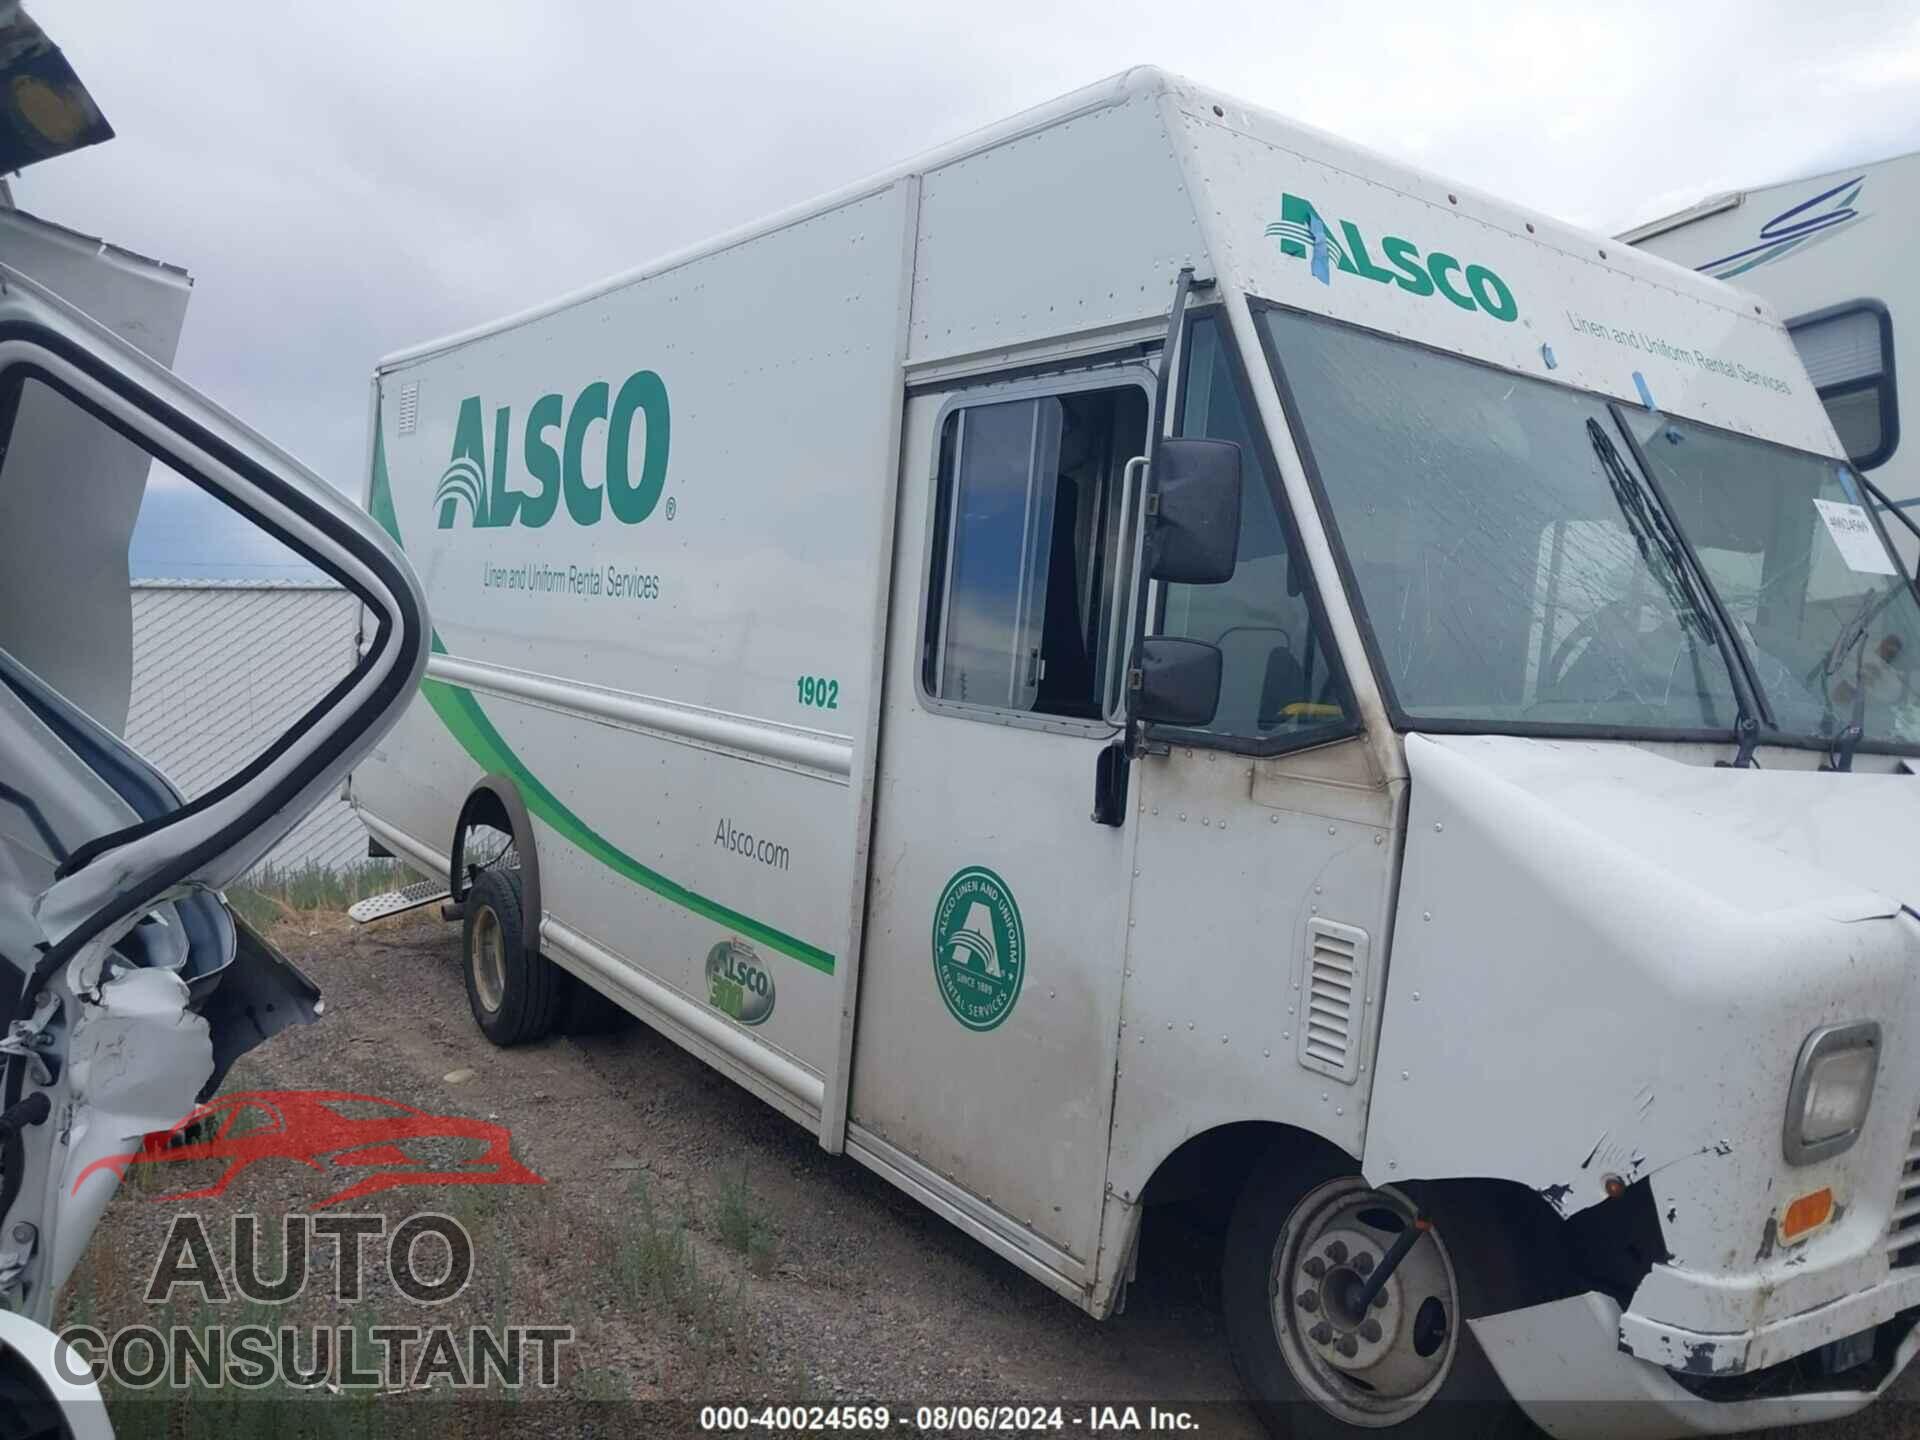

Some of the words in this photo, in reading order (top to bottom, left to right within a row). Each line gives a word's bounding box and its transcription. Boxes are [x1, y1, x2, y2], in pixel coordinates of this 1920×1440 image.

[1265, 192, 1518, 322] ALSCO
[1565, 309, 1610, 341] Linen
[1612, 326, 1639, 350] and
[1641, 333, 1697, 369] Uniform
[1693, 350, 1739, 379] Rental
[1736, 363, 1793, 396] Services
[433, 369, 670, 529] ALSCO
[484, 561, 507, 588] Linen
[508, 564, 527, 590] and
[529, 563, 566, 593] Uniform
[568, 564, 603, 596] Rental
[607, 565, 660, 600] Services
[797, 675, 839, 709] 1902
[713, 817, 790, 871] Alsco.com
[941, 896, 957, 937] ALSCO
[955, 881, 978, 899] LINEN
[980, 882, 999, 901] AND
[998, 898, 1018, 964] UNIFORM
[709, 942, 769, 997] ALSCO
[941, 964, 966, 1011] RENTAL
[968, 988, 1008, 1018] SERVICES
